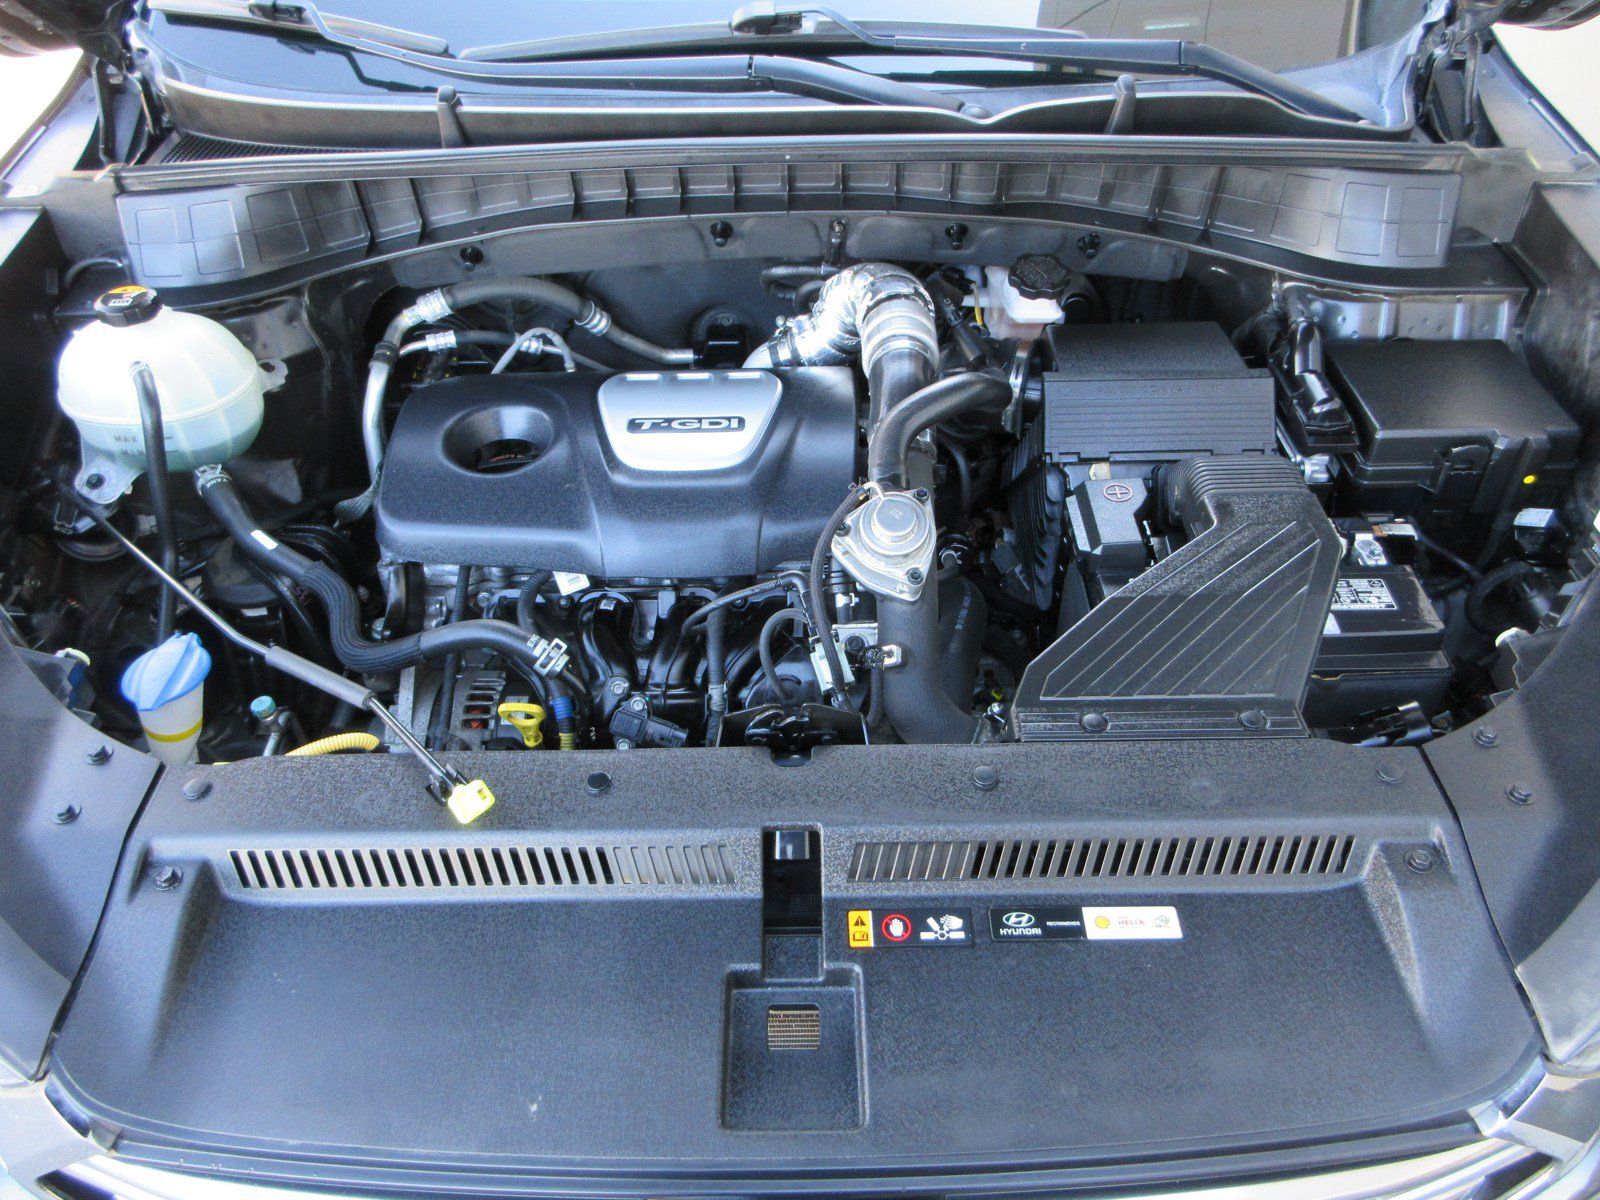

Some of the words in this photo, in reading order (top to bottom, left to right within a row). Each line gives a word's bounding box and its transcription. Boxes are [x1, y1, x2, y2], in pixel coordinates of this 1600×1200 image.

[635, 417, 739, 430] T-GDI
[113, 434, 138, 443] MAX
[204, 476, 228, 489] TANK
[1117, 918, 1146, 926] HELIX
